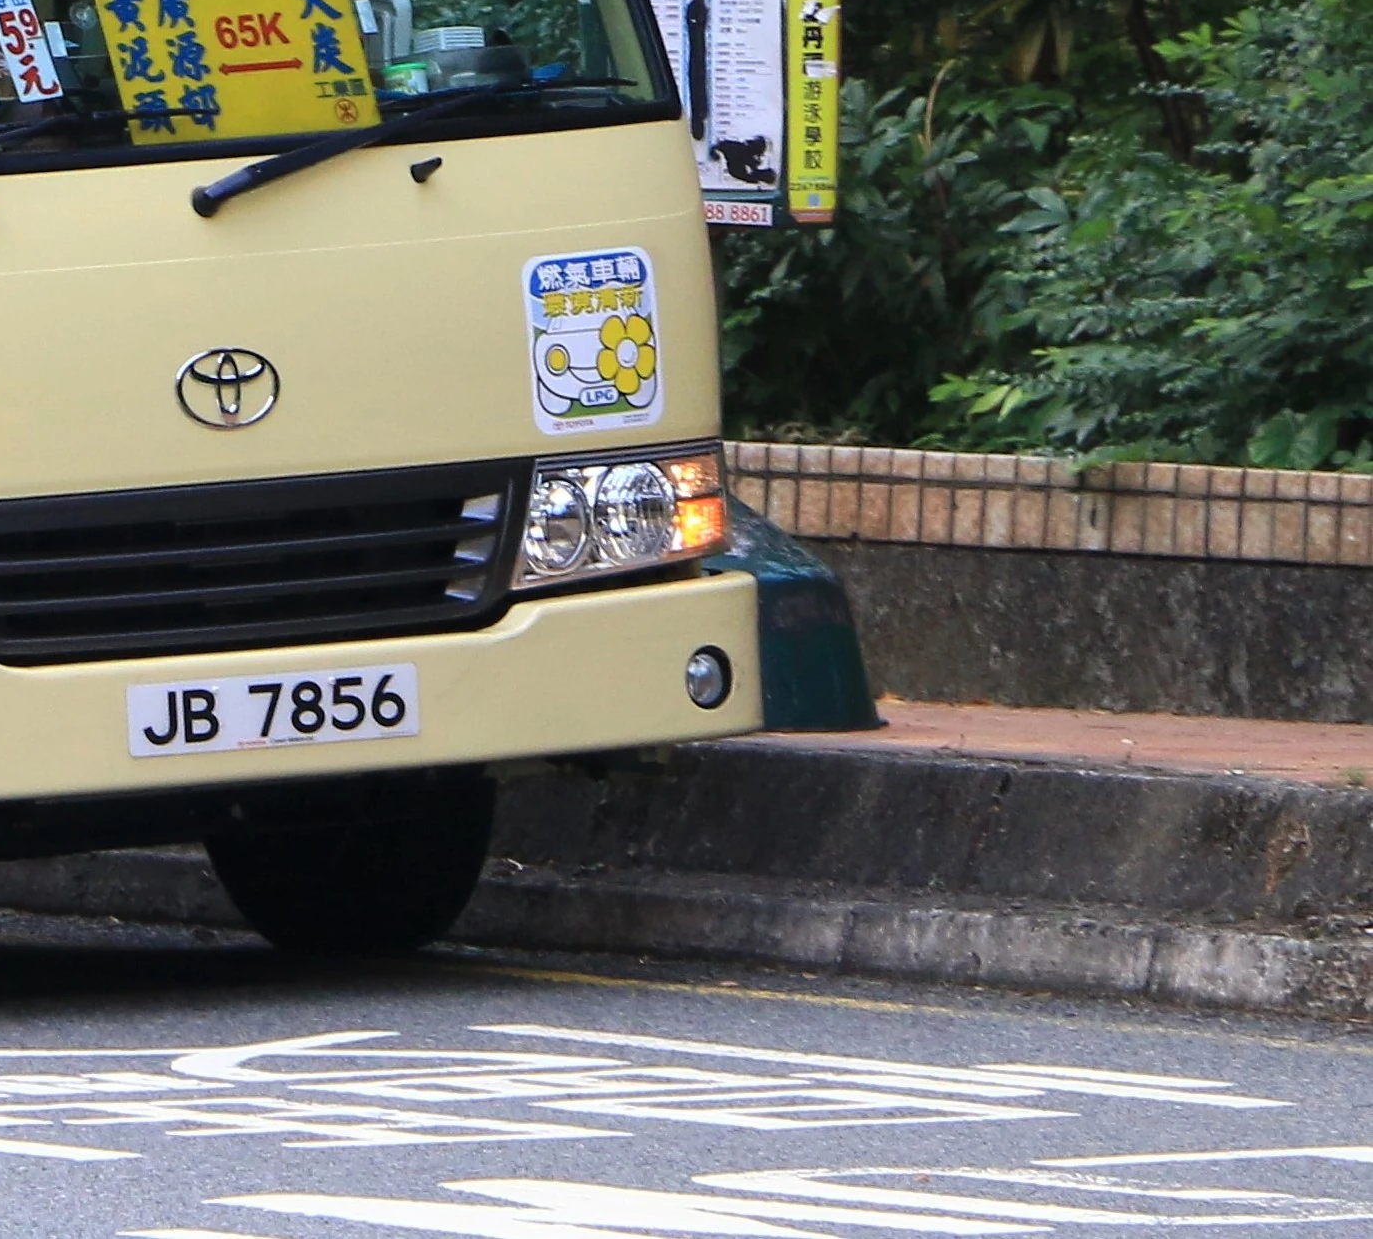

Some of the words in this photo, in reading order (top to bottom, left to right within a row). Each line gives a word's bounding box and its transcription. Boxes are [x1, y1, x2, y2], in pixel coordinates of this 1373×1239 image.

[214, 11, 291, 50] 65K
[19, 54, 60, 96] 元
[705, 204, 725, 221] 88
[731, 204, 768, 223] 8861
[586, 390, 615, 404] LPG
[143, 689, 221, 745] JB
[247, 673, 407, 738] 7856
